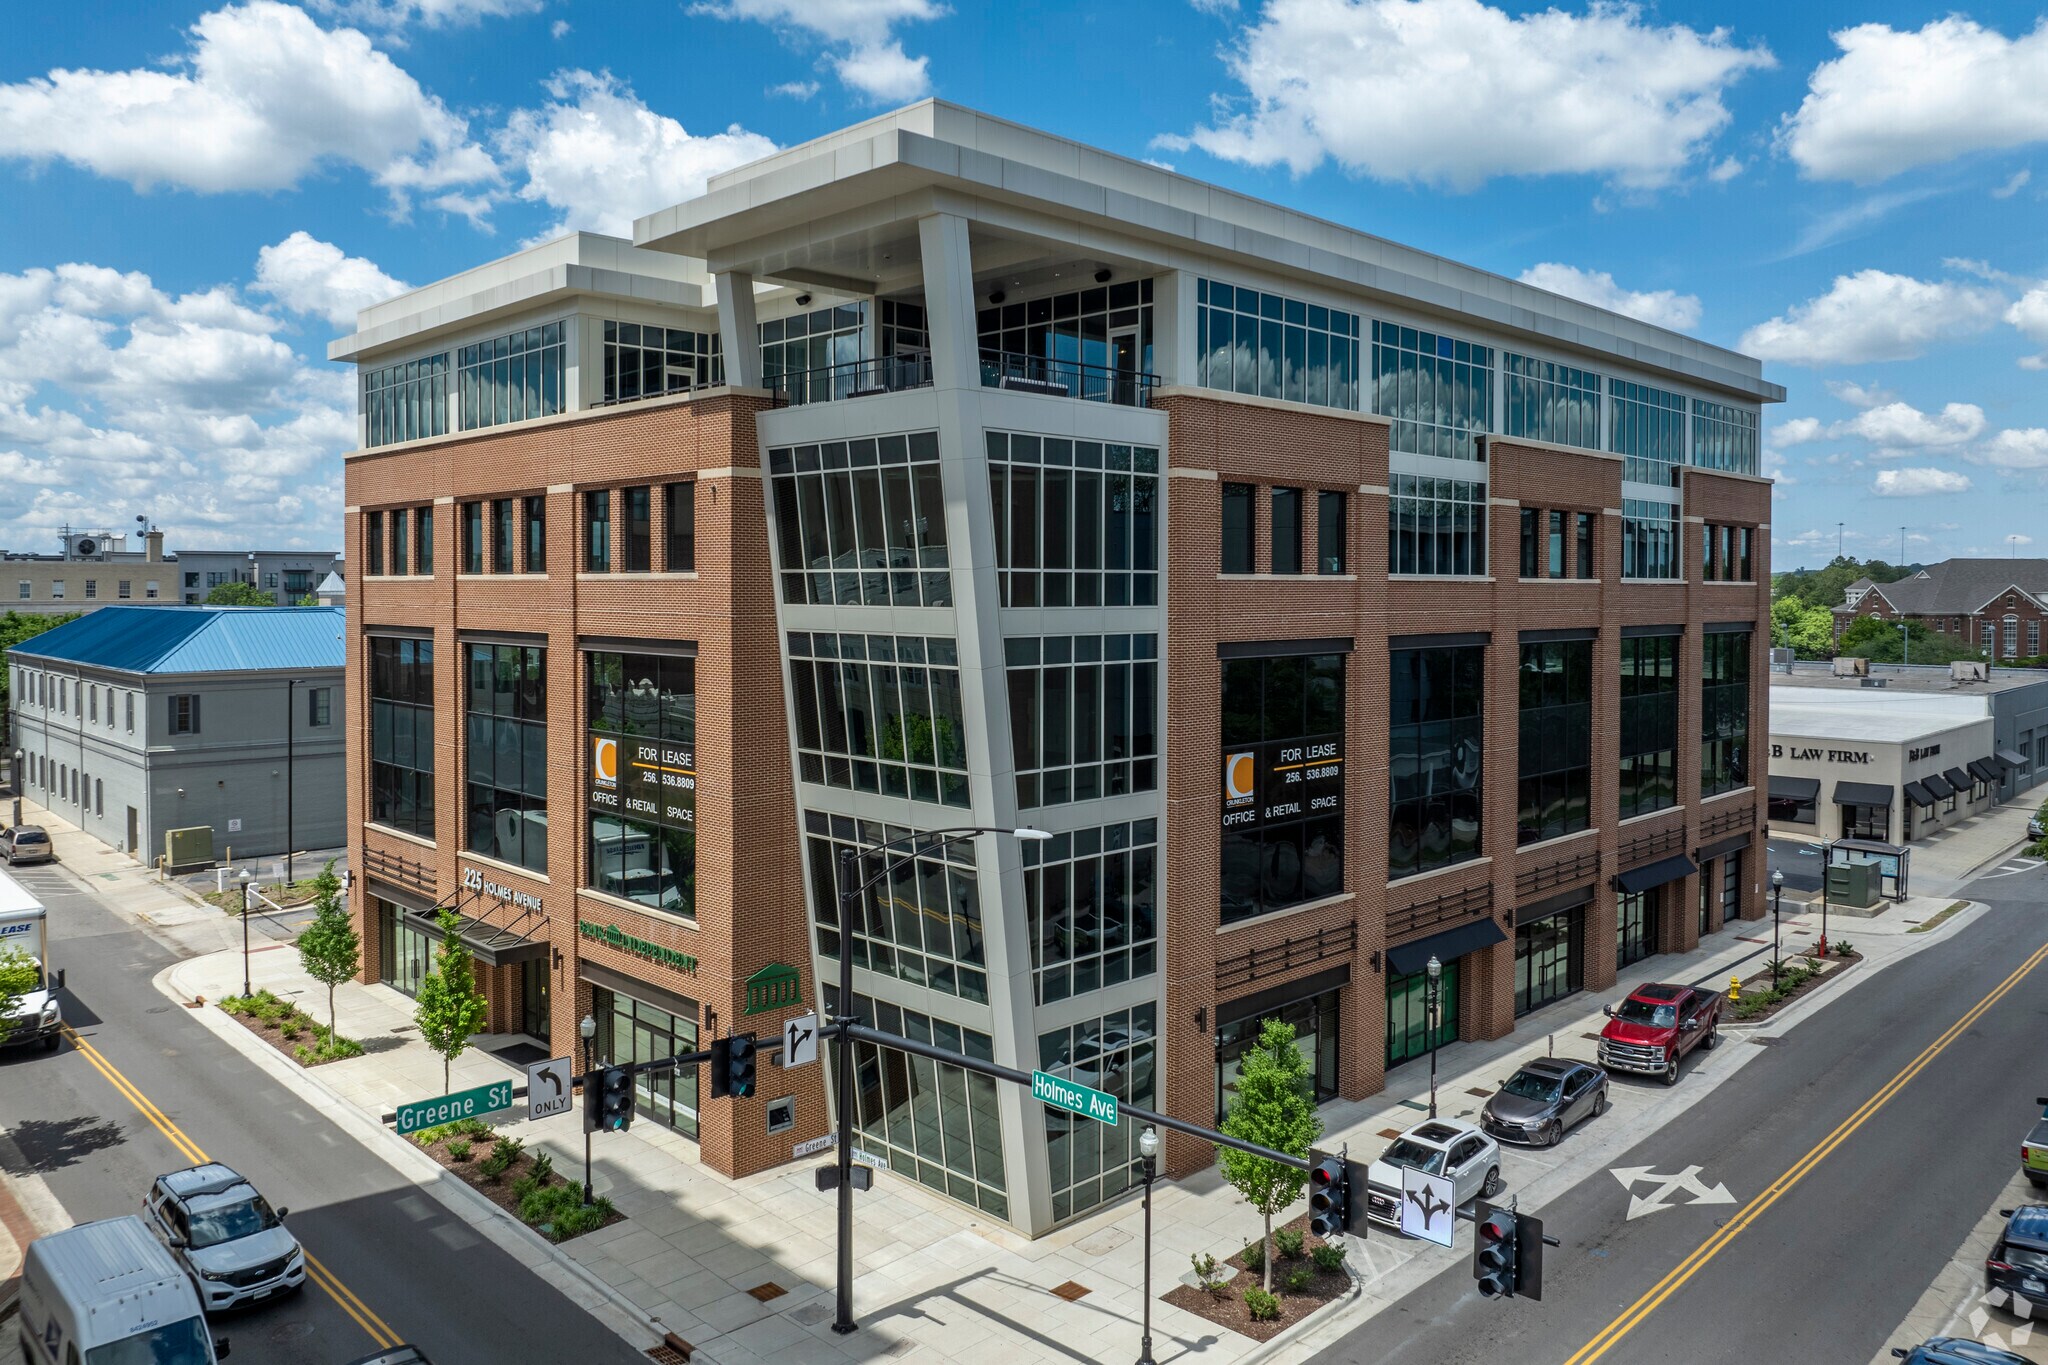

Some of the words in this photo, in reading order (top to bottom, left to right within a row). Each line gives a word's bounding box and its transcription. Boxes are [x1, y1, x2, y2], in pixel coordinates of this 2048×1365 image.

[638, 747, 658, 762] FOR
[662, 750, 692, 767] LEASE
[1281, 748, 1302, 762] FOR
[1306, 743, 1337, 759] LEASE
[1790, 747, 1823, 760] LAW
[1828, 750, 1868, 764] FIRM
[643, 771, 658, 784] 256.
[662, 774, 695, 790] 536.8809
[1285, 772, 1302, 783] 256.
[1306, 766, 1339, 780] 536.8809
[592, 791, 618, 806] OFFICE
[626, 798, 631, 808] &
[632, 799, 658, 814] RETAIL
[667, 806, 693, 821] SPACE
[1223, 810, 1256, 826] OFFICE
[1265, 807, 1272, 818] &
[1273, 803, 1302, 817] RETAIL
[1311, 796, 1337, 809] SPACE
[464, 867, 482, 890] 225
[484, 881, 513, 901] HOLMES
[514, 891, 542, 911] AVENUE
[621, 932, 697, 972] INDEPENDENT
[535, 1097, 566, 1115] ONLY
[1035, 1074, 1083, 1109] Holmes
[1089, 1093, 1115, 1120] Ave
[401, 1098, 474, 1130] Greene
[488, 1086, 509, 1108] St
[805, 1139, 827, 1153] Greene
[830, 1134, 837, 1145] St
